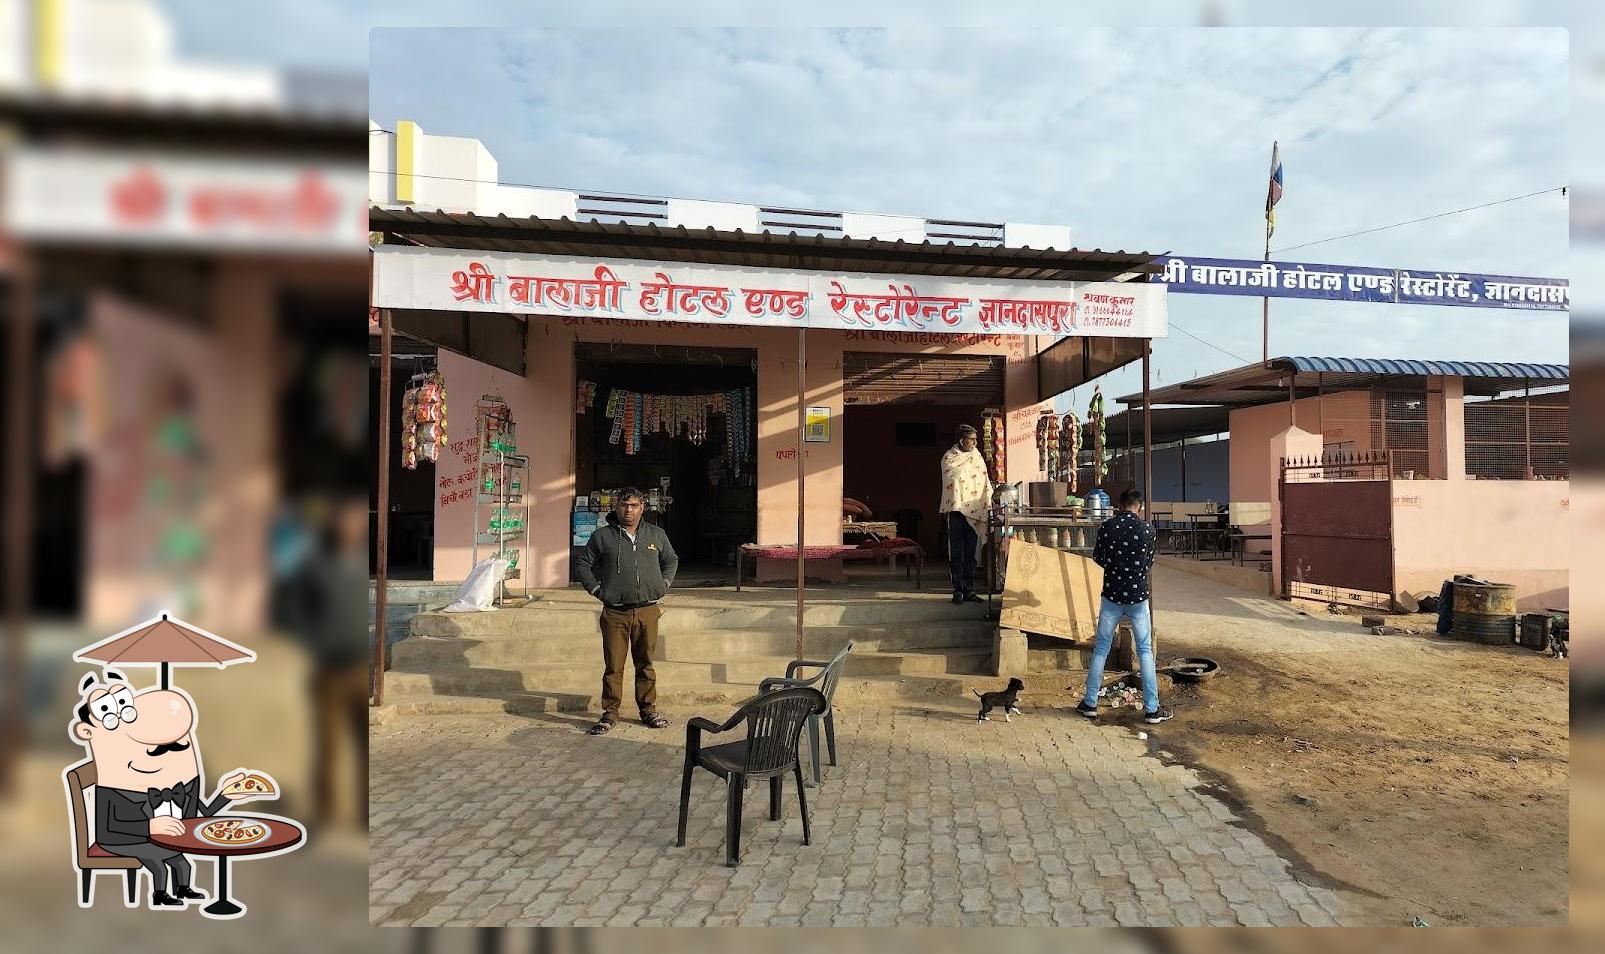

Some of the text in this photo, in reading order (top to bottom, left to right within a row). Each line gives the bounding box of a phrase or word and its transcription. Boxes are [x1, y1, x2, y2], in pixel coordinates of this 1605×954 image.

[449, 261, 497, 304] श्री
[504, 264, 628, 312] बालाजी
[639, 272, 731, 316] होटल
[740, 288, 809, 318] एण्ड
[827, 281, 970, 327] रेस्टोरेन्ट
[1192, 264, 1280, 288] बालाजी
[1282, 267, 1342, 291] होटल
[1347, 273, 1395, 294] एण्ड
